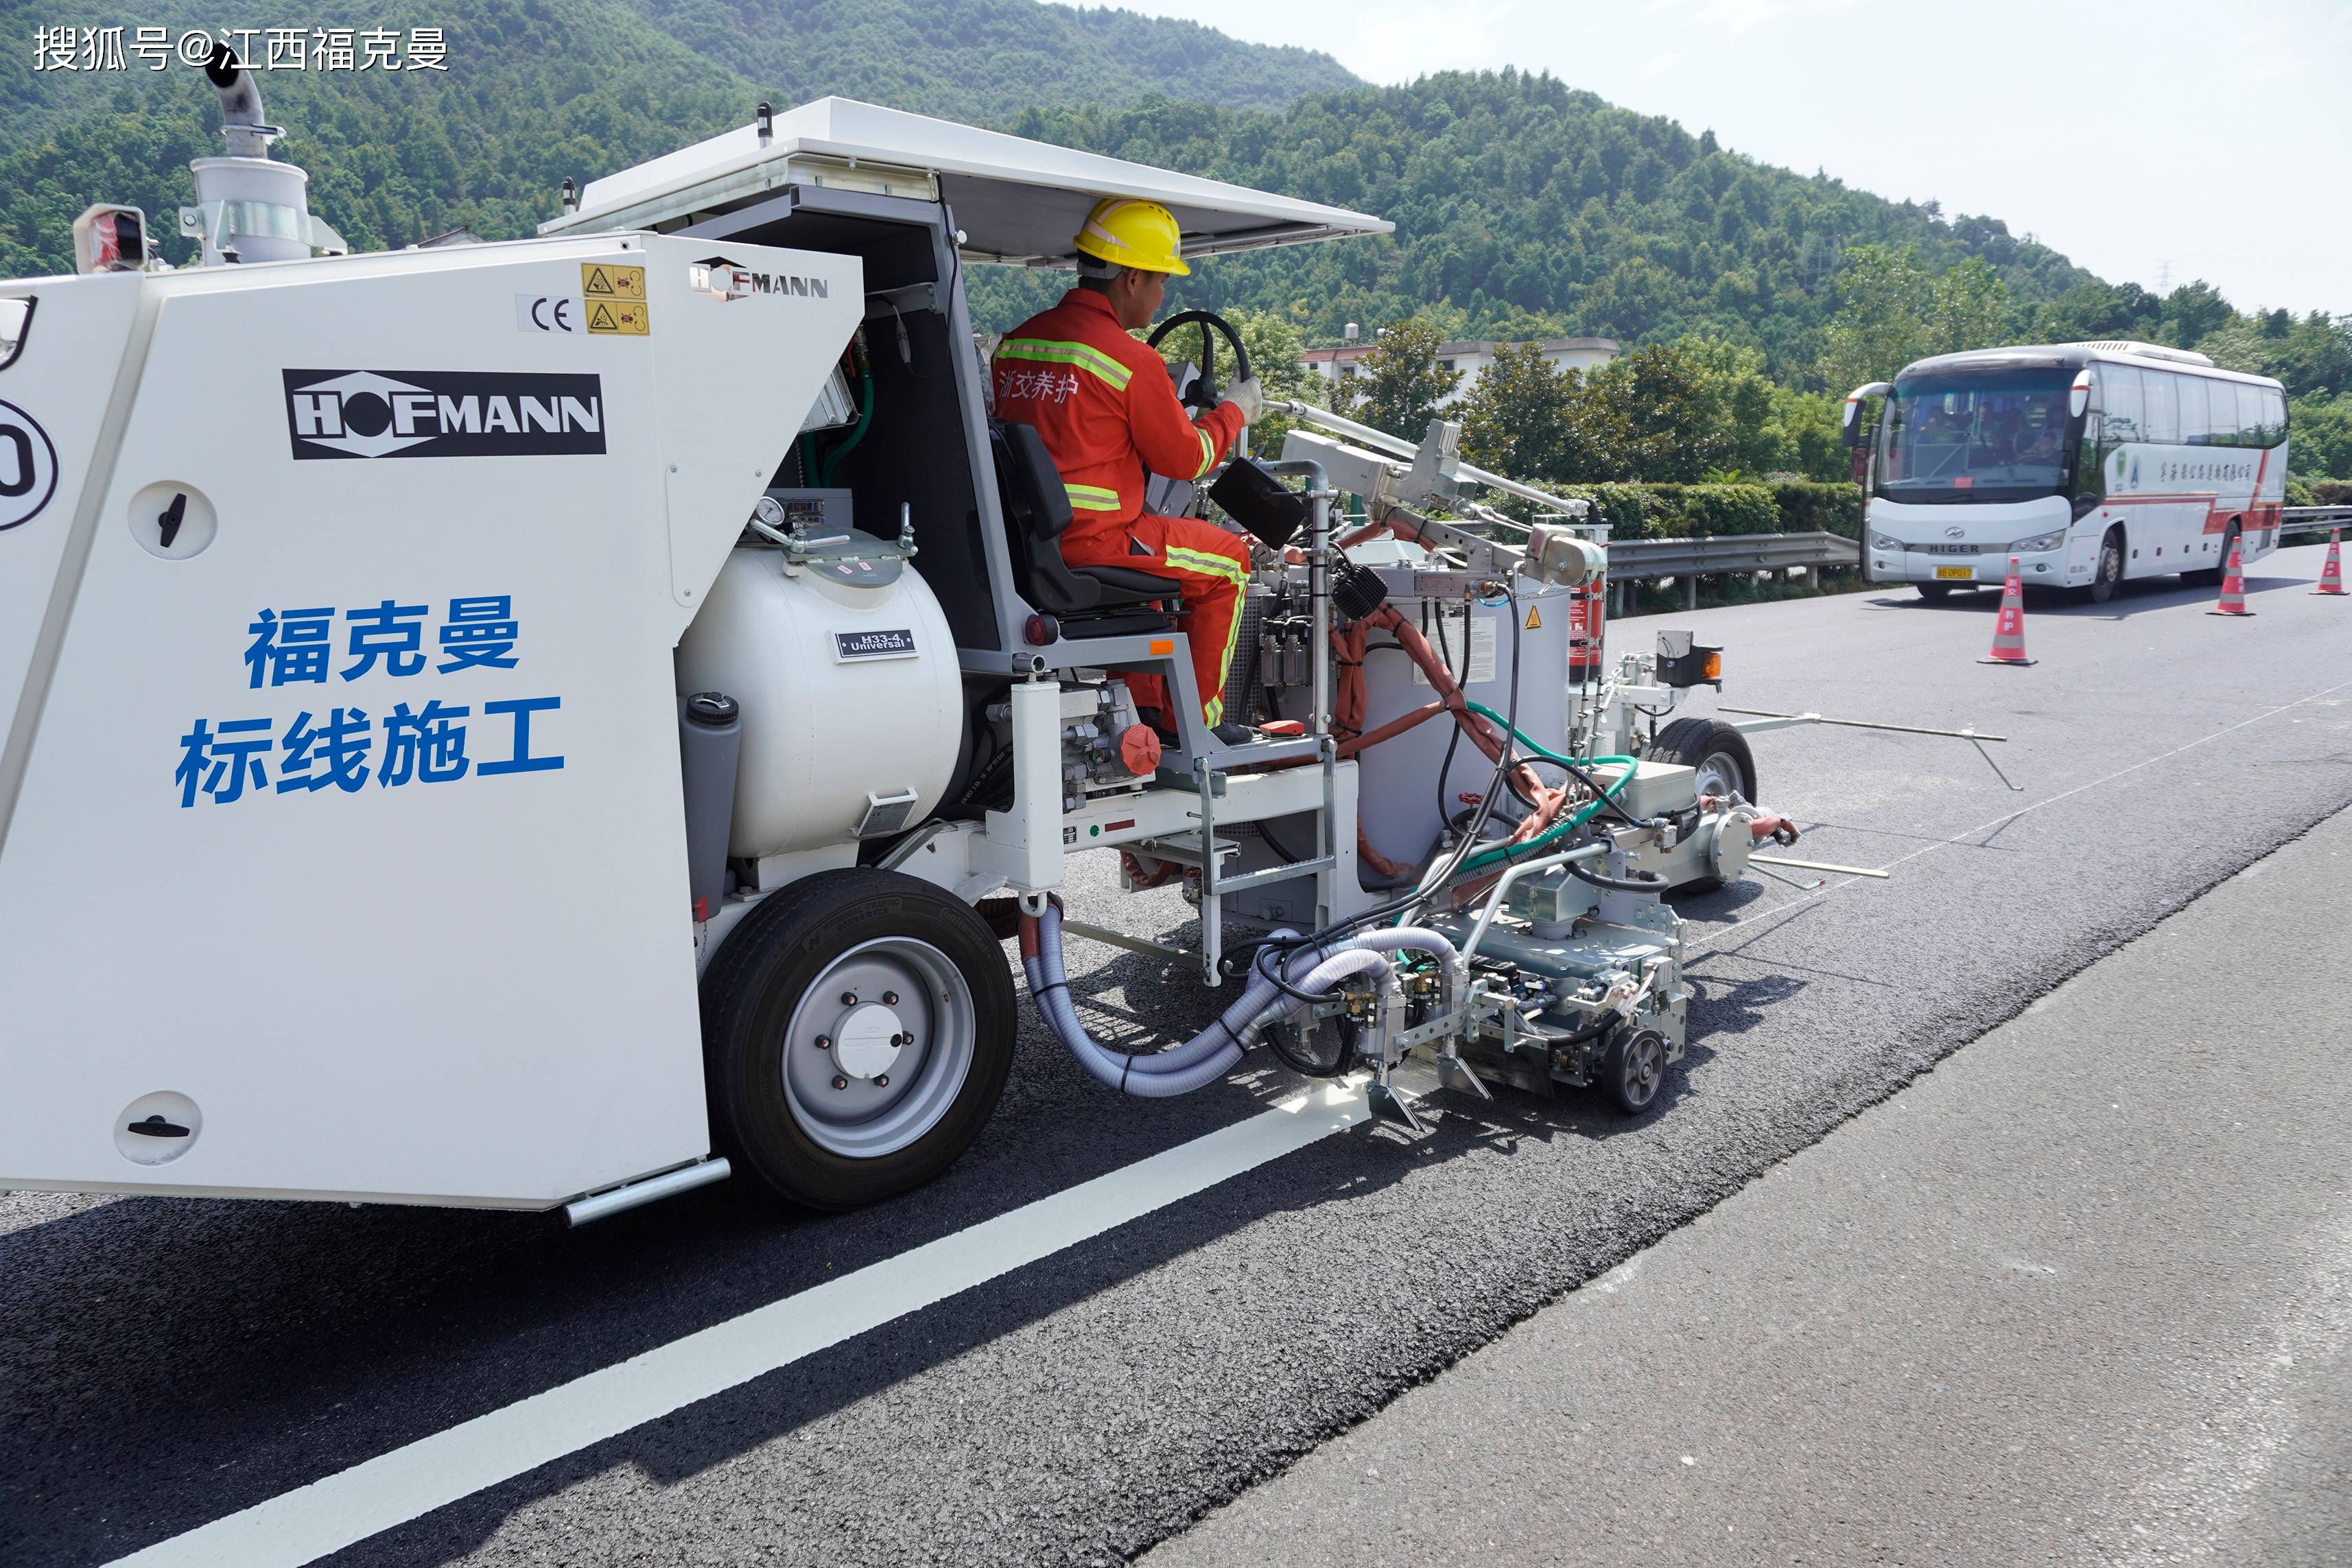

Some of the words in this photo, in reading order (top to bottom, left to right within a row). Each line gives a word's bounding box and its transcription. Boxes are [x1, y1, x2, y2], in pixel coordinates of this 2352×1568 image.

[690, 257, 828, 303] HOFMANN
[999, 370, 1079, 404] 浙交养护
[293, 370, 600, 458] HOFMANN
[1929, 545, 1979, 553] HIGER
[244, 595, 520, 689] 福克曼
[851, 639, 905, 651] Universal
[861, 633, 901, 644] H33-4
[176, 696, 565, 808] 标线施工
